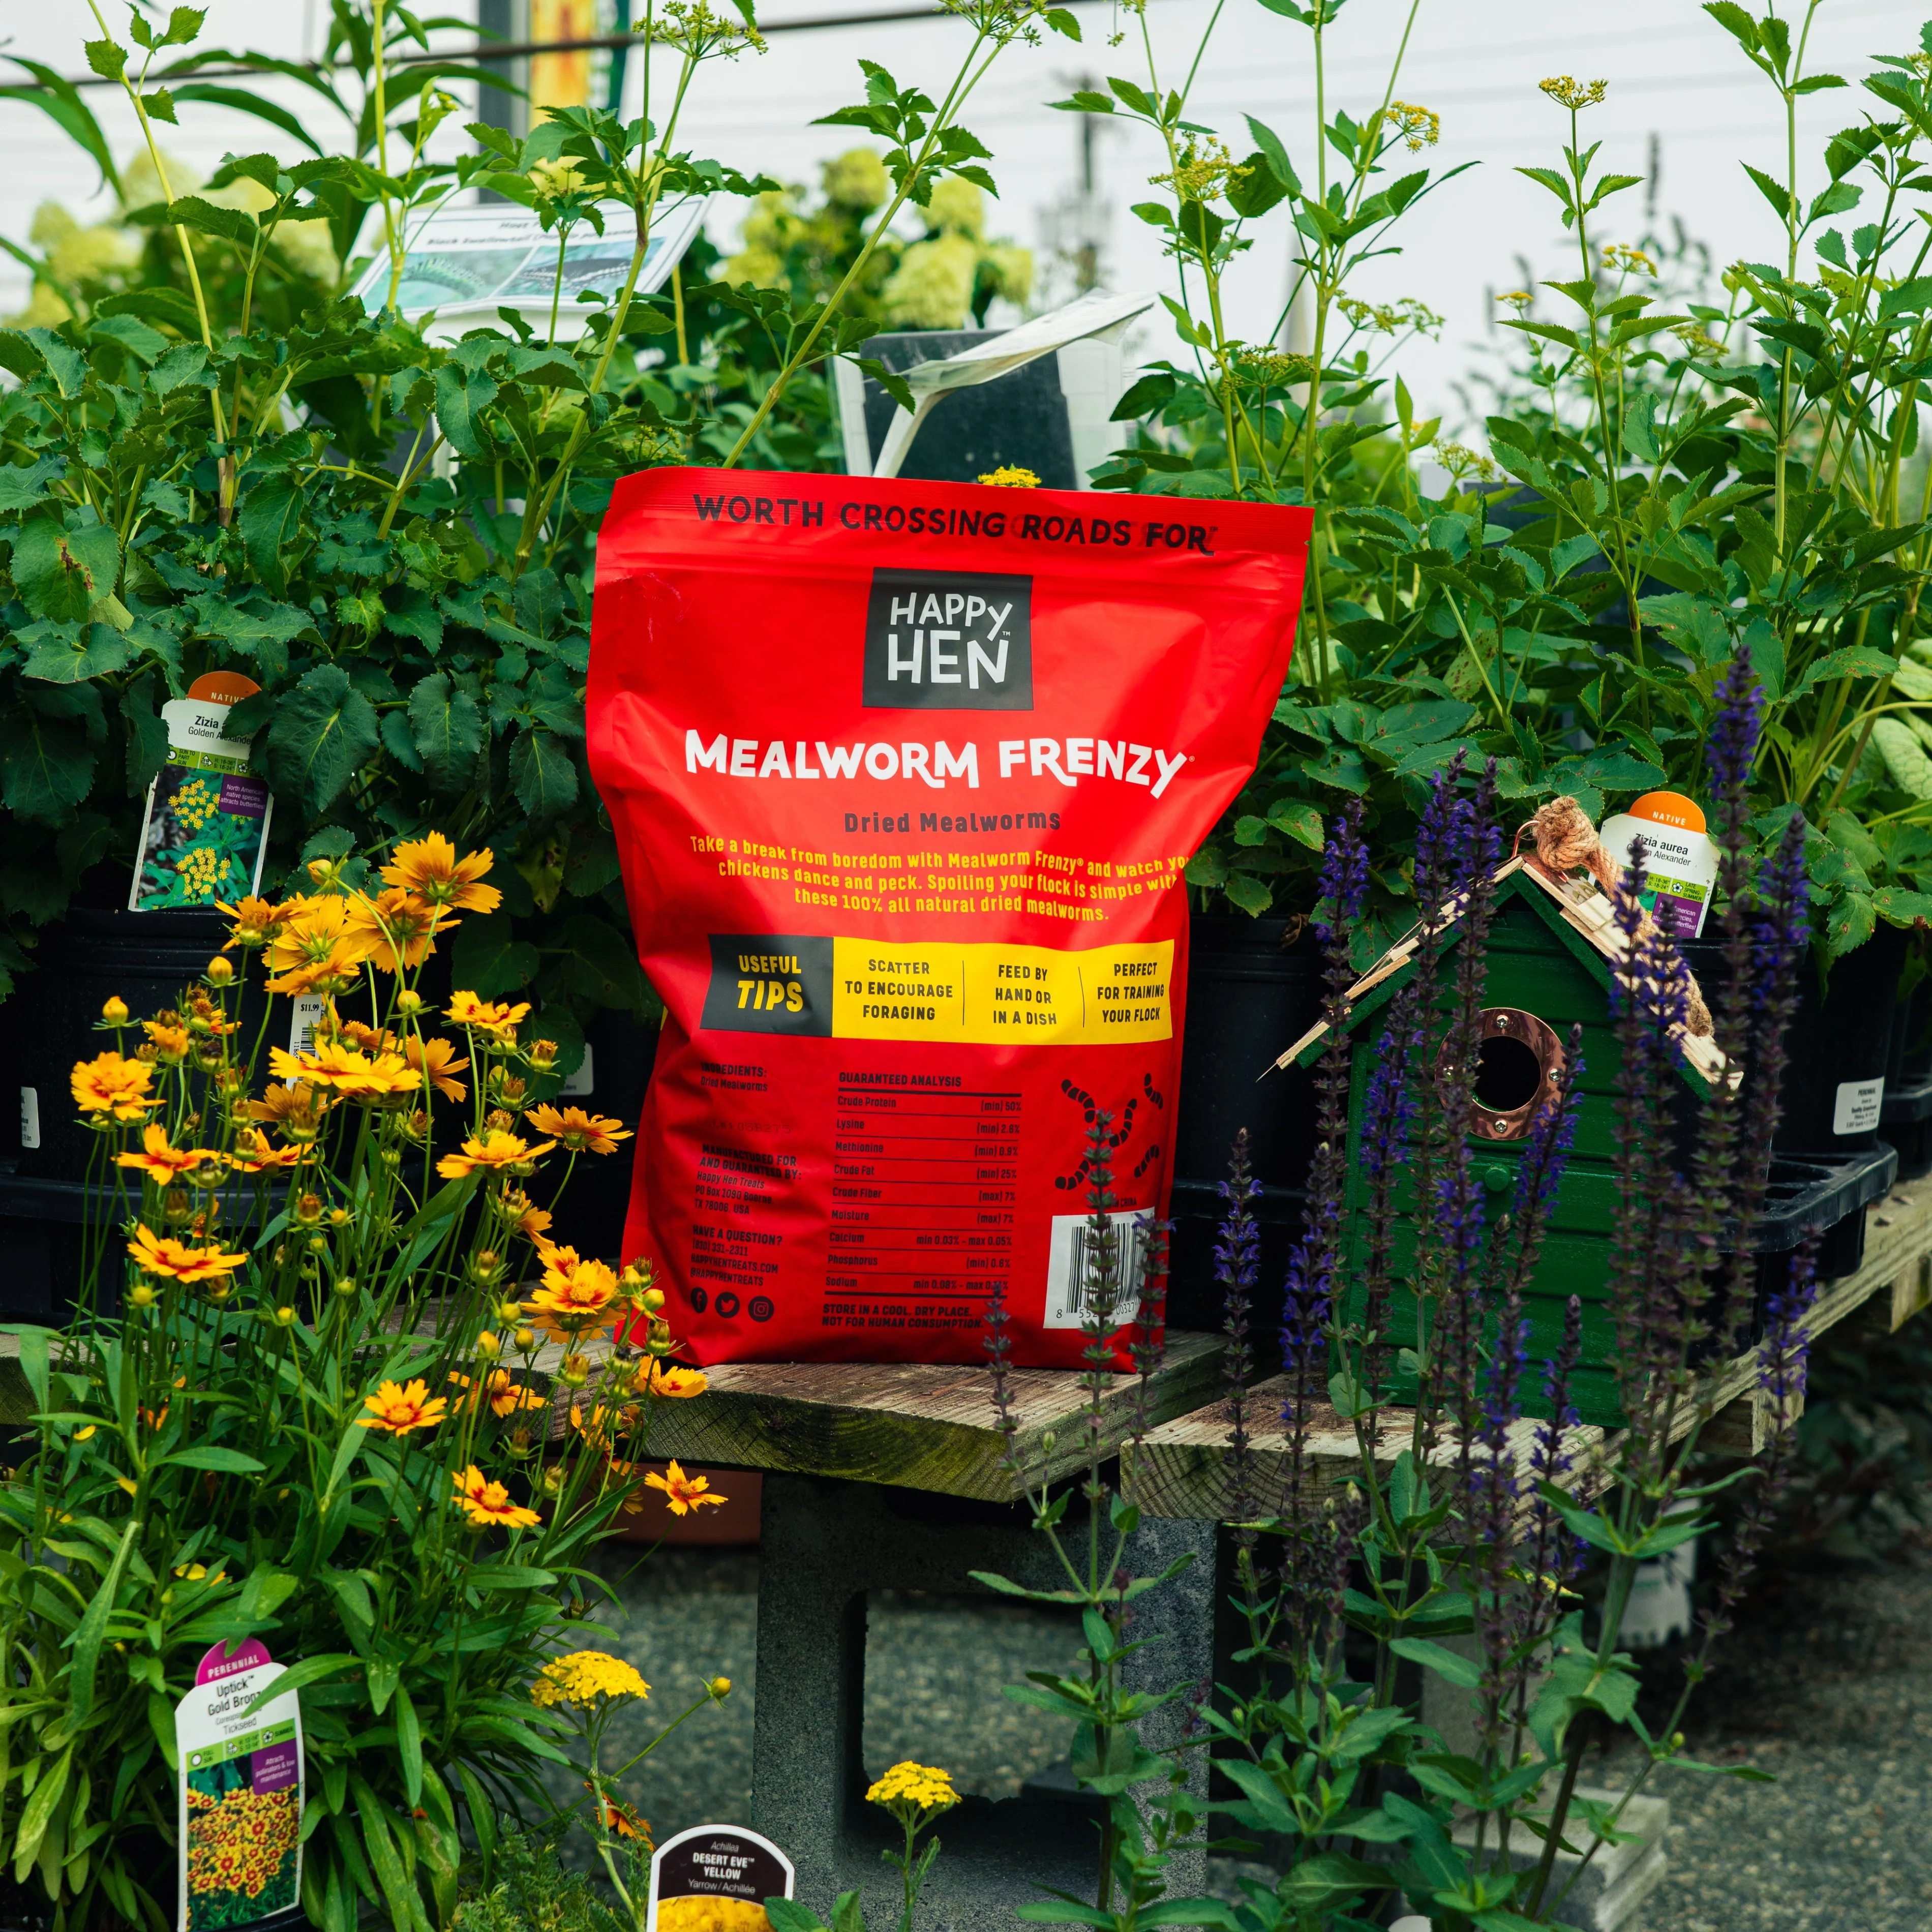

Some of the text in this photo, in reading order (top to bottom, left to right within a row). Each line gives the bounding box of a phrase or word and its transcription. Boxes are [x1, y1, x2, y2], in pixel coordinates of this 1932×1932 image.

[692, 494, 824, 527] WORTH
[840, 503, 1005, 538] CROSSING
[1021, 514, 1131, 547] ROADS
[890, 592, 1013, 642] HAPPY
[195, 715, 218, 729] Zizia
[189, 727, 214, 738] Golden
[685, 729, 979, 789] MEALWORM
[240, 786, 264, 795] American
[239, 800, 265, 809] butterflies!
[845, 812, 1060, 833] Dried Mealworms
[1653, 811, 1686, 826] NATIVE
[1660, 842, 1688, 855] aurea
[690, 836, 724, 853] Take
[730, 839, 737, 853] a
[743, 839, 786, 860] break
[791, 848, 827, 866] from
[833, 853, 901, 868] boredom
[908, 852, 943, 868] with
[948, 851, 1030, 868] Mealworm
[1088, 861, 1110, 878] and
[1116, 859, 1163, 879] watch
[1654, 851, 1691, 866] Alexander
[719, 860, 789, 880] chickens
[794, 868, 839, 887] dance
[844, 876, 872, 891] and
[879, 875, 922, 893] peck.
[927, 874, 994, 893] Spoiling
[1000, 876, 1033, 892] your
[1038, 874, 1070, 896] flock
[1075, 880, 1085, 898] is
[1090, 883, 1142, 900] simple
[795, 888, 1109, 921] these 100% all natural dried mealworms.
[1682, 893, 1702, 901] SUMMER
[738, 955, 802, 974] USEFUL
[868, 959, 930, 975] SCATTER
[1114, 962, 1157, 976] PERFECT
[999, 964, 1048, 981] FEED BY
[737, 980, 803, 1012] TIPS
[844, 981, 953, 998] TO ENCOURAGE
[995, 988, 1051, 1004] HAND OR
[1097, 984, 1164, 1000] FOR TRAINING
[863, 1005, 935, 1020] FORAGING
[993, 1010, 1057, 1025] IN A DISH
[1102, 1007, 1160, 1023] YOUR FLOCK
[701, 1063, 767, 1077] INGREDIENTS:
[701, 1076, 768, 1092] Dried Mealworms
[839, 1072, 961, 1087] GUARANTEED ANALYSIS
[838, 1096, 1021, 1111] Crude Protein 50%
[836, 1119, 1020, 1134] Lysine 2.6%
[702, 1143, 796, 1166] MANUFACTURED FOR
[835, 1141, 1018, 1156] Methionine 0.9%
[699, 1157, 802, 1180] AND GUARANTEED BY:
[834, 1164, 1016, 1179] Crude Fat 25%
[697, 1171, 765, 1189] Happy Hen Treats
[696, 1185, 705, 1194] PO
[707, 1186, 720, 1196] Box
[722, 1189, 741, 1200] 1090
[832, 1187, 1015, 1201] Crude Fiber 7%
[695, 1198, 703, 1209] TX
[734, 1204, 749, 1215] USA
[1121, 1197, 1137, 1207] CHINA
[831, 1210, 1013, 1224] Moisture 7%
[693, 1225, 782, 1246] HAVE A QUESTION?
[830, 1232, 1012, 1246] Calcium 0.03% 0.05%
[692, 1238, 748, 1257] (830) 331-2311
[691, 1253, 778, 1274] HAPPYHENTREATS.COM
[828, 1254, 1011, 1269] Phosphorus 0.6%
[690, 1267, 764, 1286] @HAPPYHENTREATS
[826, 1276, 957, 1290] Sodium 0.08%
[823, 1304, 856, 1315] STORE
[858, 1305, 870, 1315] IN
[872, 1305, 880, 1315] A
[915, 1306, 935, 1316] DRY
[938, 1307, 972, 1317] PLACE.
[822, 1316, 984, 1329] NOT FOR HUMAN CONSUMPTION.
[207, 1655, 259, 1678] PERENNIAL
[208, 1700, 230, 1716] Gold
[224, 1716, 257, 1734] Tickseed
[711, 1841, 739, 1853] Achillea
[693, 1853, 728, 1865] DESERT
[704, 1866, 741, 1880] YELLOW
